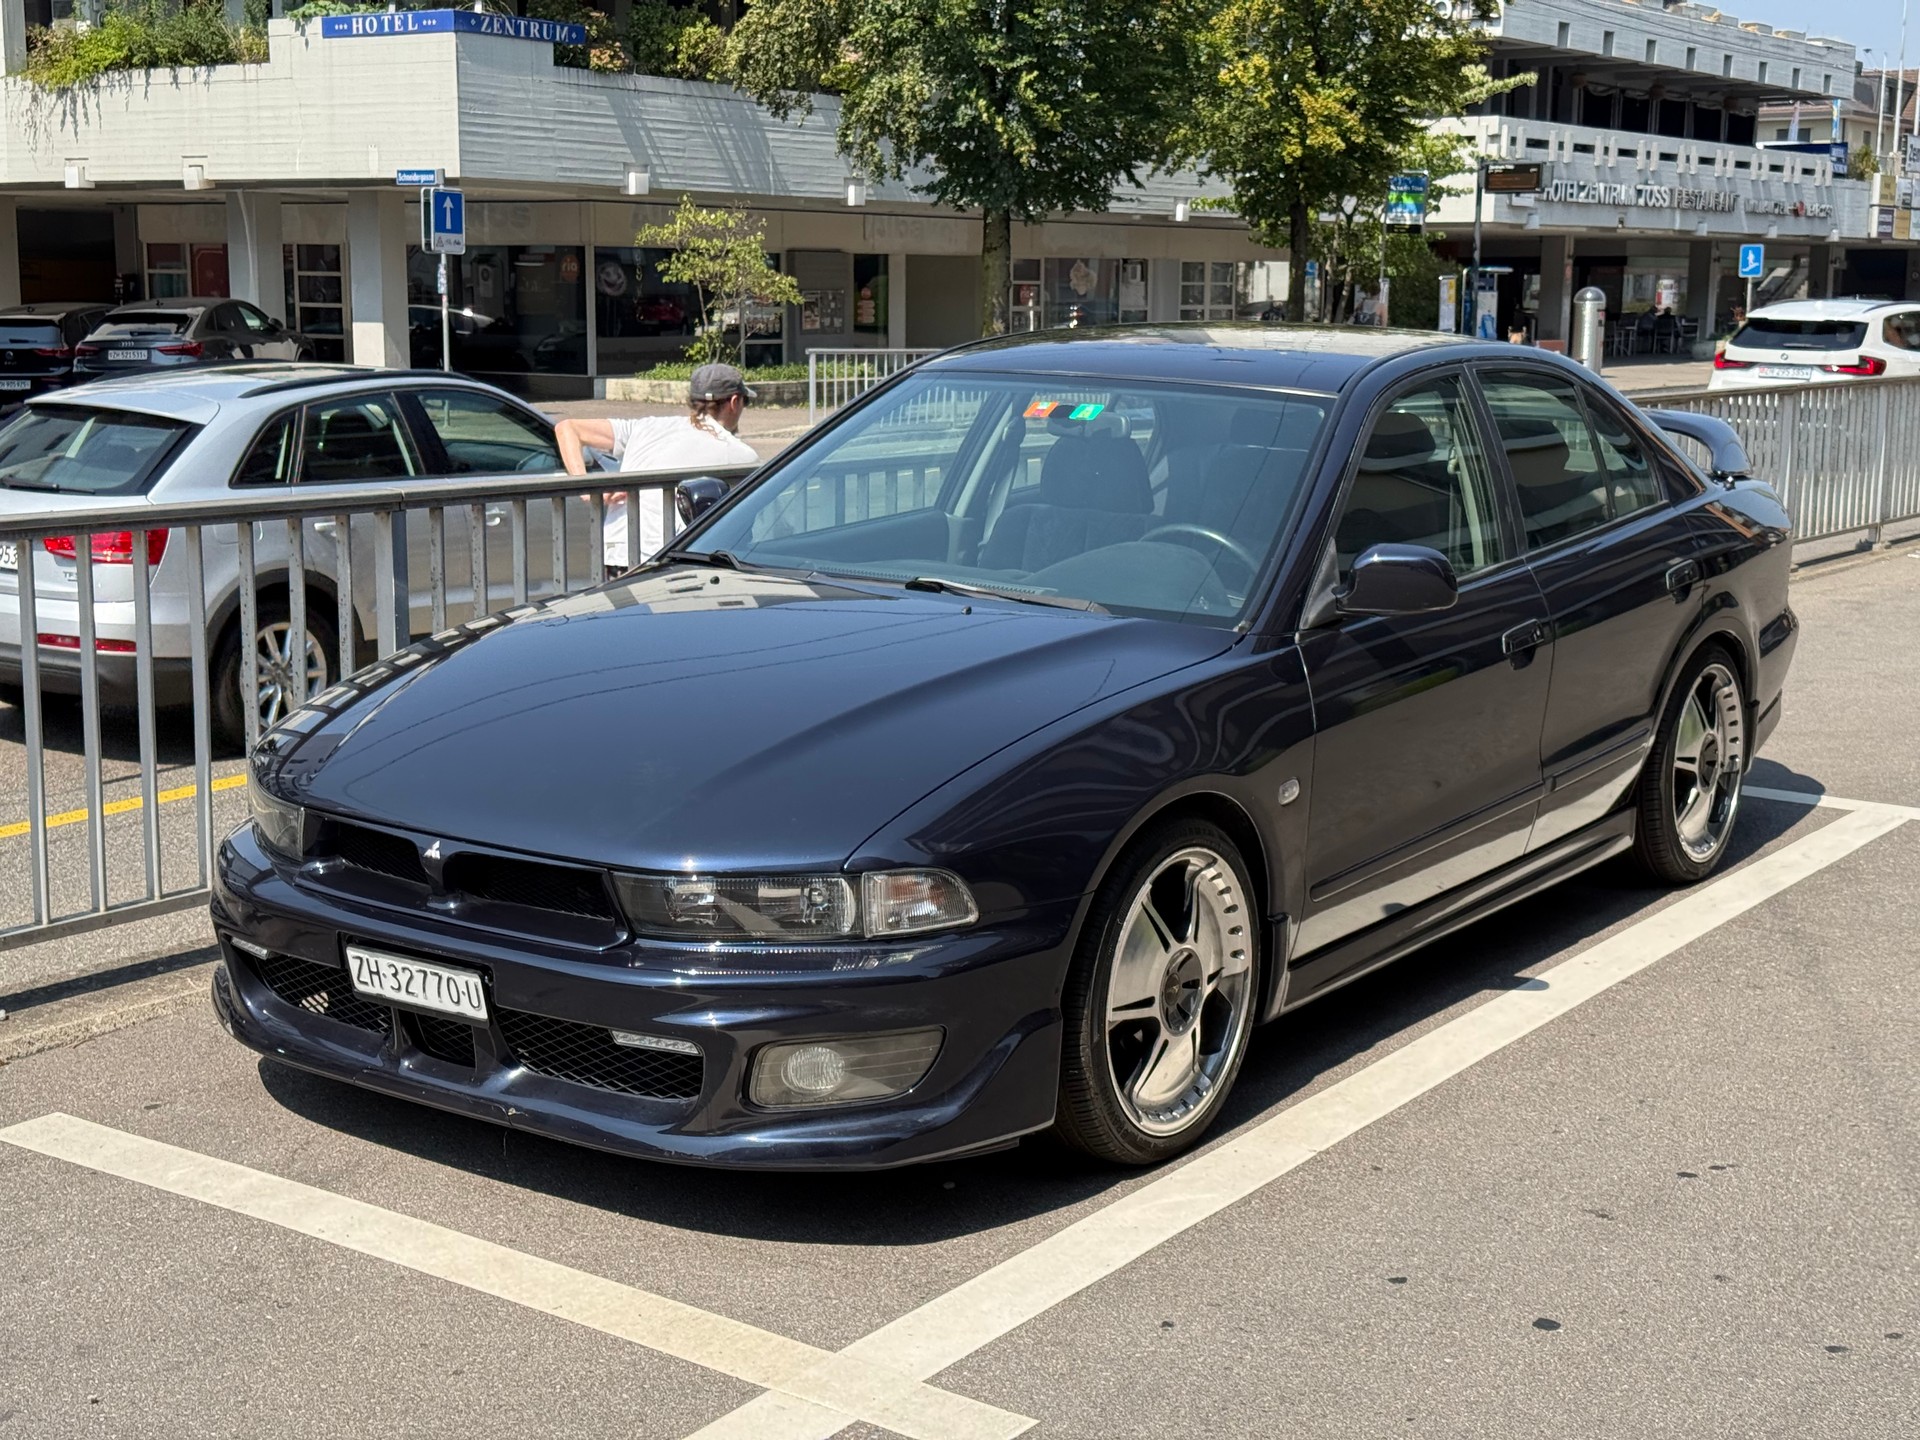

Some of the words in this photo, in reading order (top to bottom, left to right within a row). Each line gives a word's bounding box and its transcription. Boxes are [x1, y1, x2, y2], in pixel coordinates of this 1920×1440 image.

[351, 13, 419, 35] HOTEL
[480, 15, 570, 43] ZENTRUM
[1543, 178, 1579, 202] HOTEL
